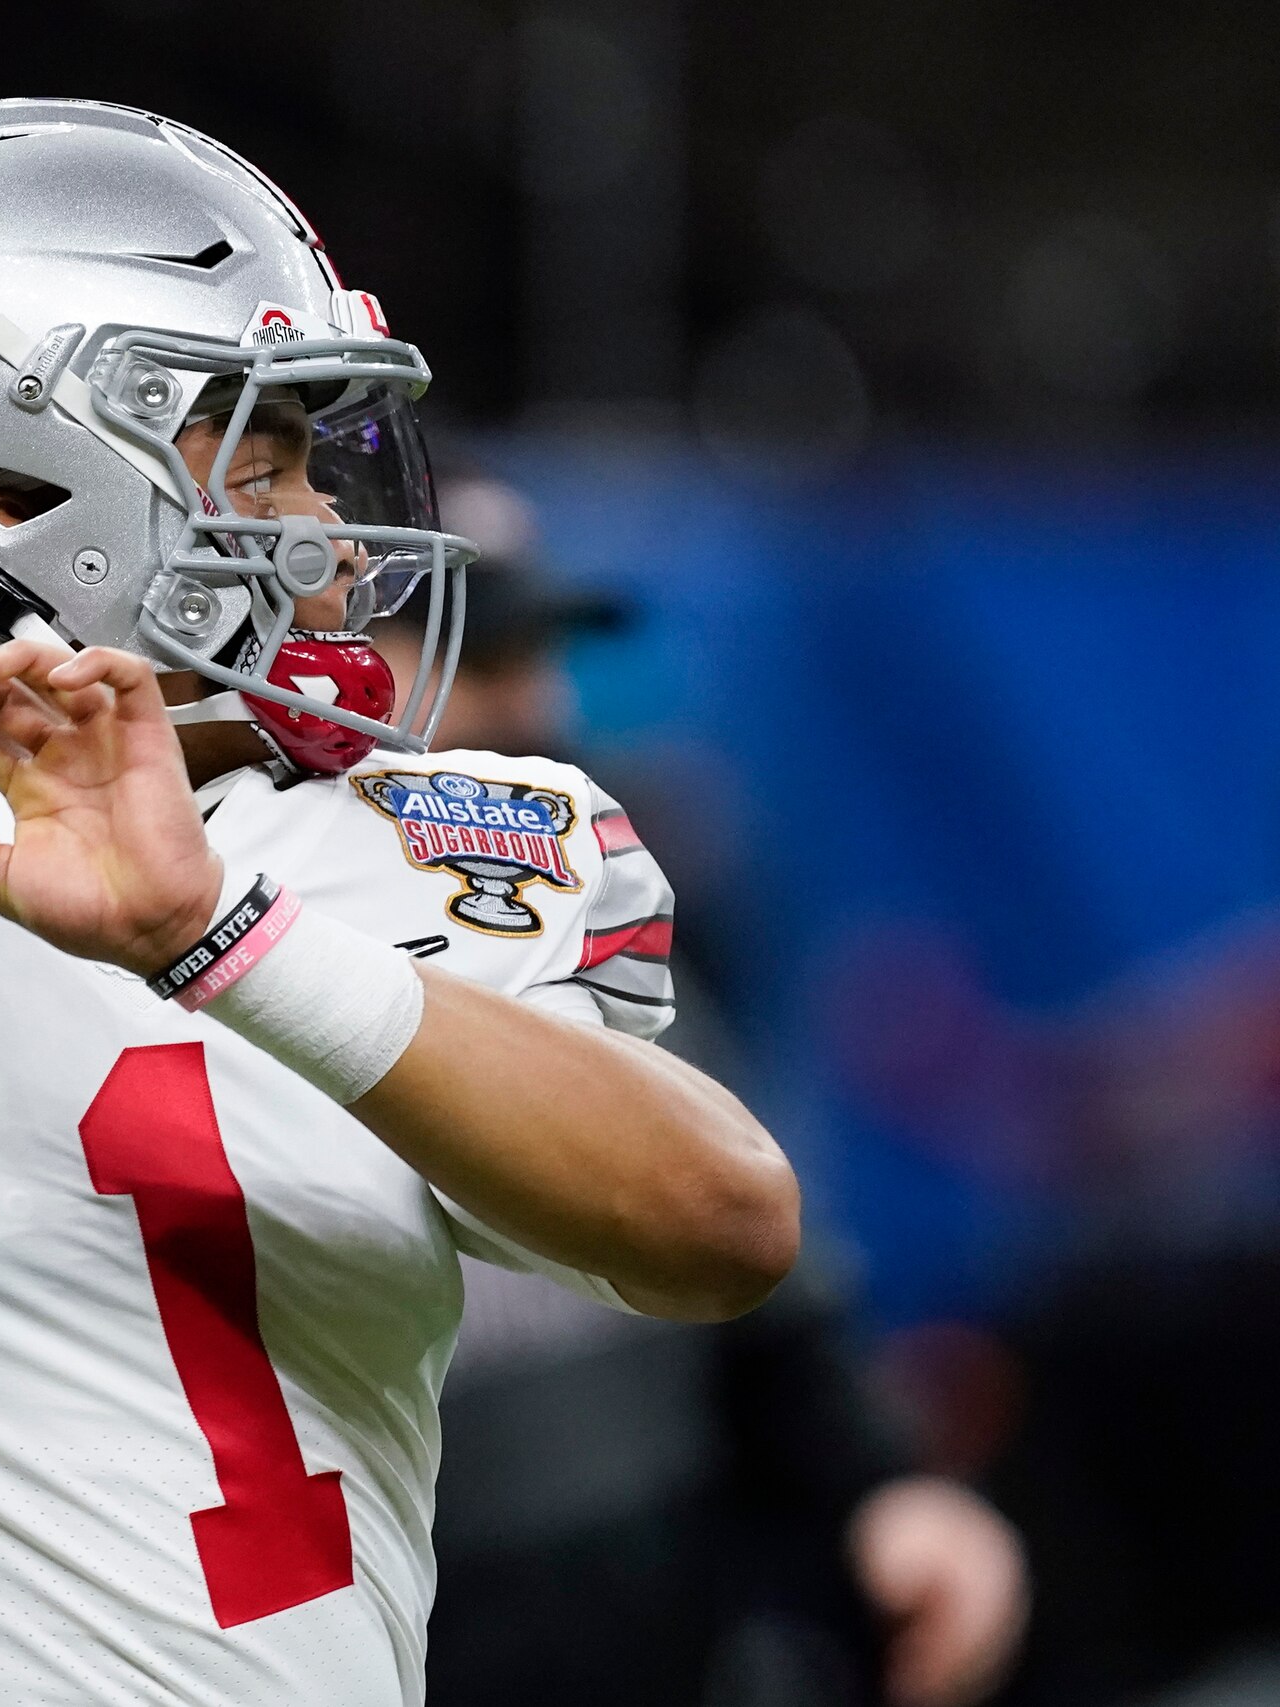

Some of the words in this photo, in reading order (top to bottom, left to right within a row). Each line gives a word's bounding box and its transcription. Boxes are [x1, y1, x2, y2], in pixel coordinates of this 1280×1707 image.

[401, 792, 544, 830] Allstate
[169, 946, 215, 986] OVER
[211, 901, 260, 950] HYPE
[203, 946, 254, 991] HYPE
[78, 1041, 354, 1629] 1
